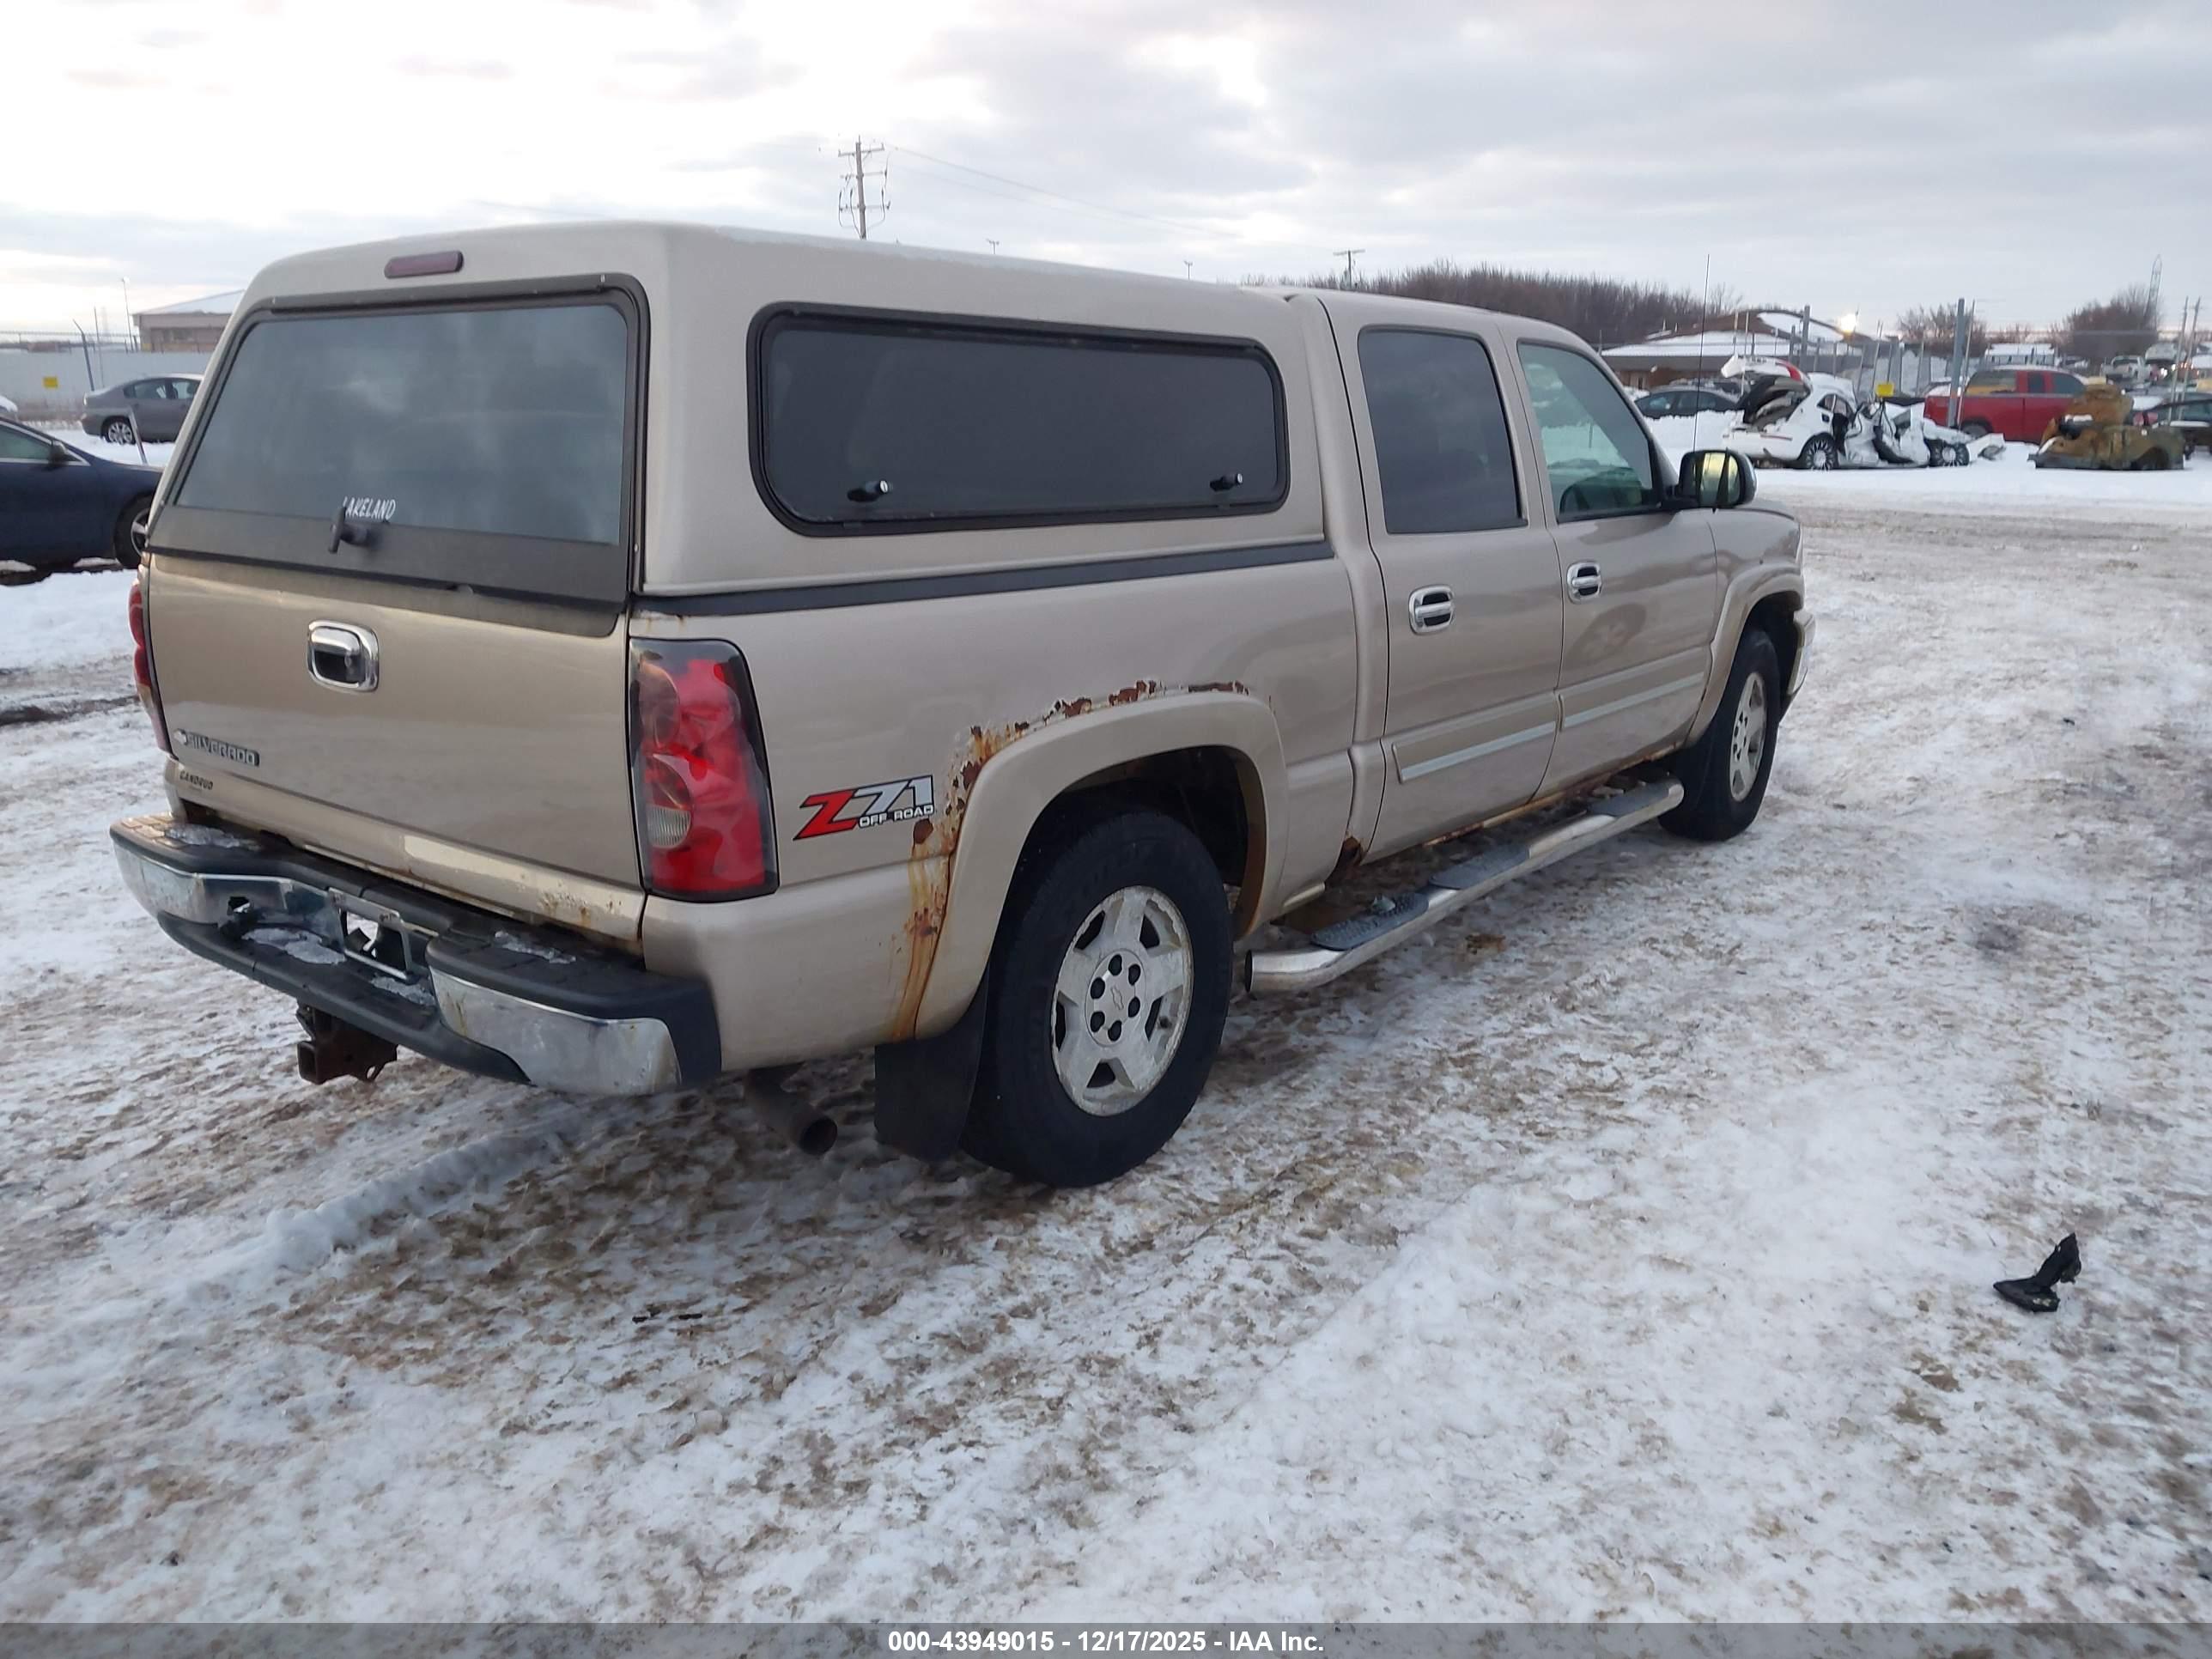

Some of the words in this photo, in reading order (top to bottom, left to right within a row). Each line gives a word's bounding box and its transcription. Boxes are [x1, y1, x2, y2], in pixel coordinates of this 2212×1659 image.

[793, 775, 934, 841] Z71
[859, 813, 888, 829] OFF
[894, 805, 934, 821] ROAD
